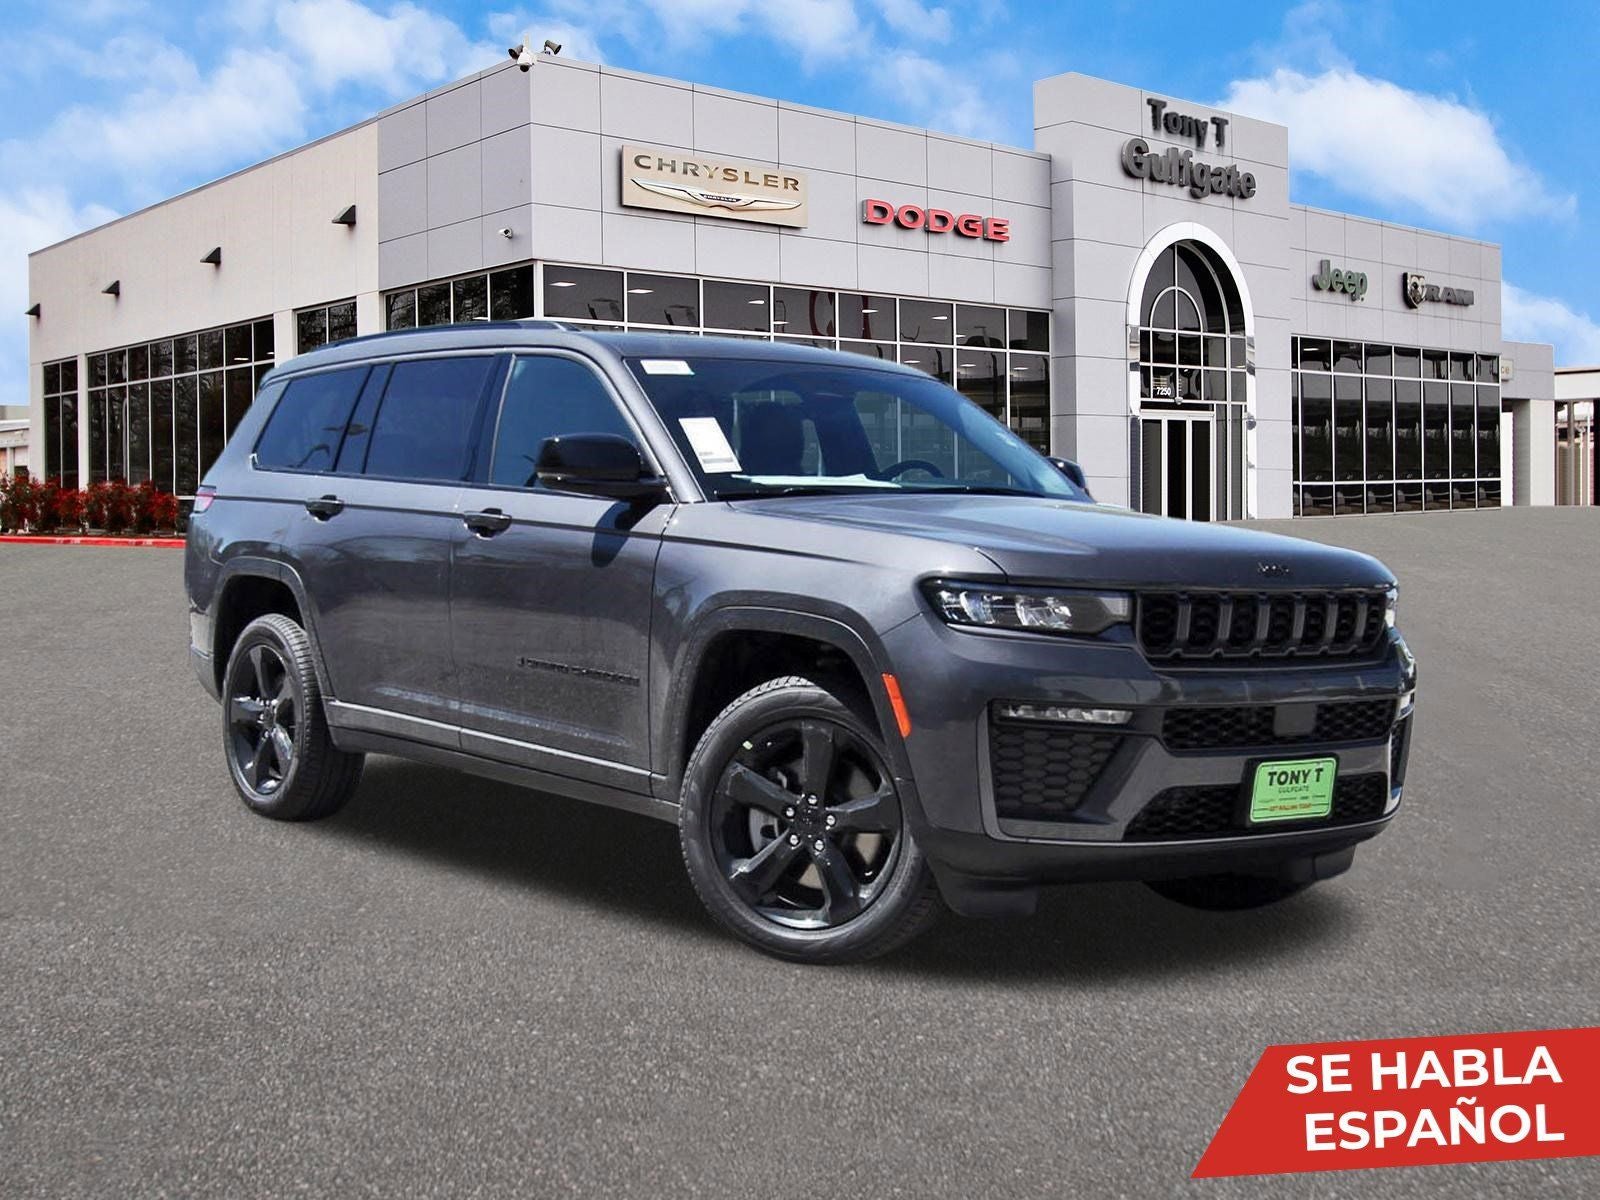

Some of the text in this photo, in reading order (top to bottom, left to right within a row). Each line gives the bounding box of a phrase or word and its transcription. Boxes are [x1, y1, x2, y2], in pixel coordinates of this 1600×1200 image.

[1147, 98, 1229, 148] Tony T
[632, 154, 801, 192] CHRYSLER
[1121, 138, 1256, 199] Gulfgate
[862, 198, 1011, 243] DODGE
[1312, 259, 1368, 302] Jeep
[1424, 283, 1475, 306] RAM
[1268, 767, 1324, 787] TONY T
